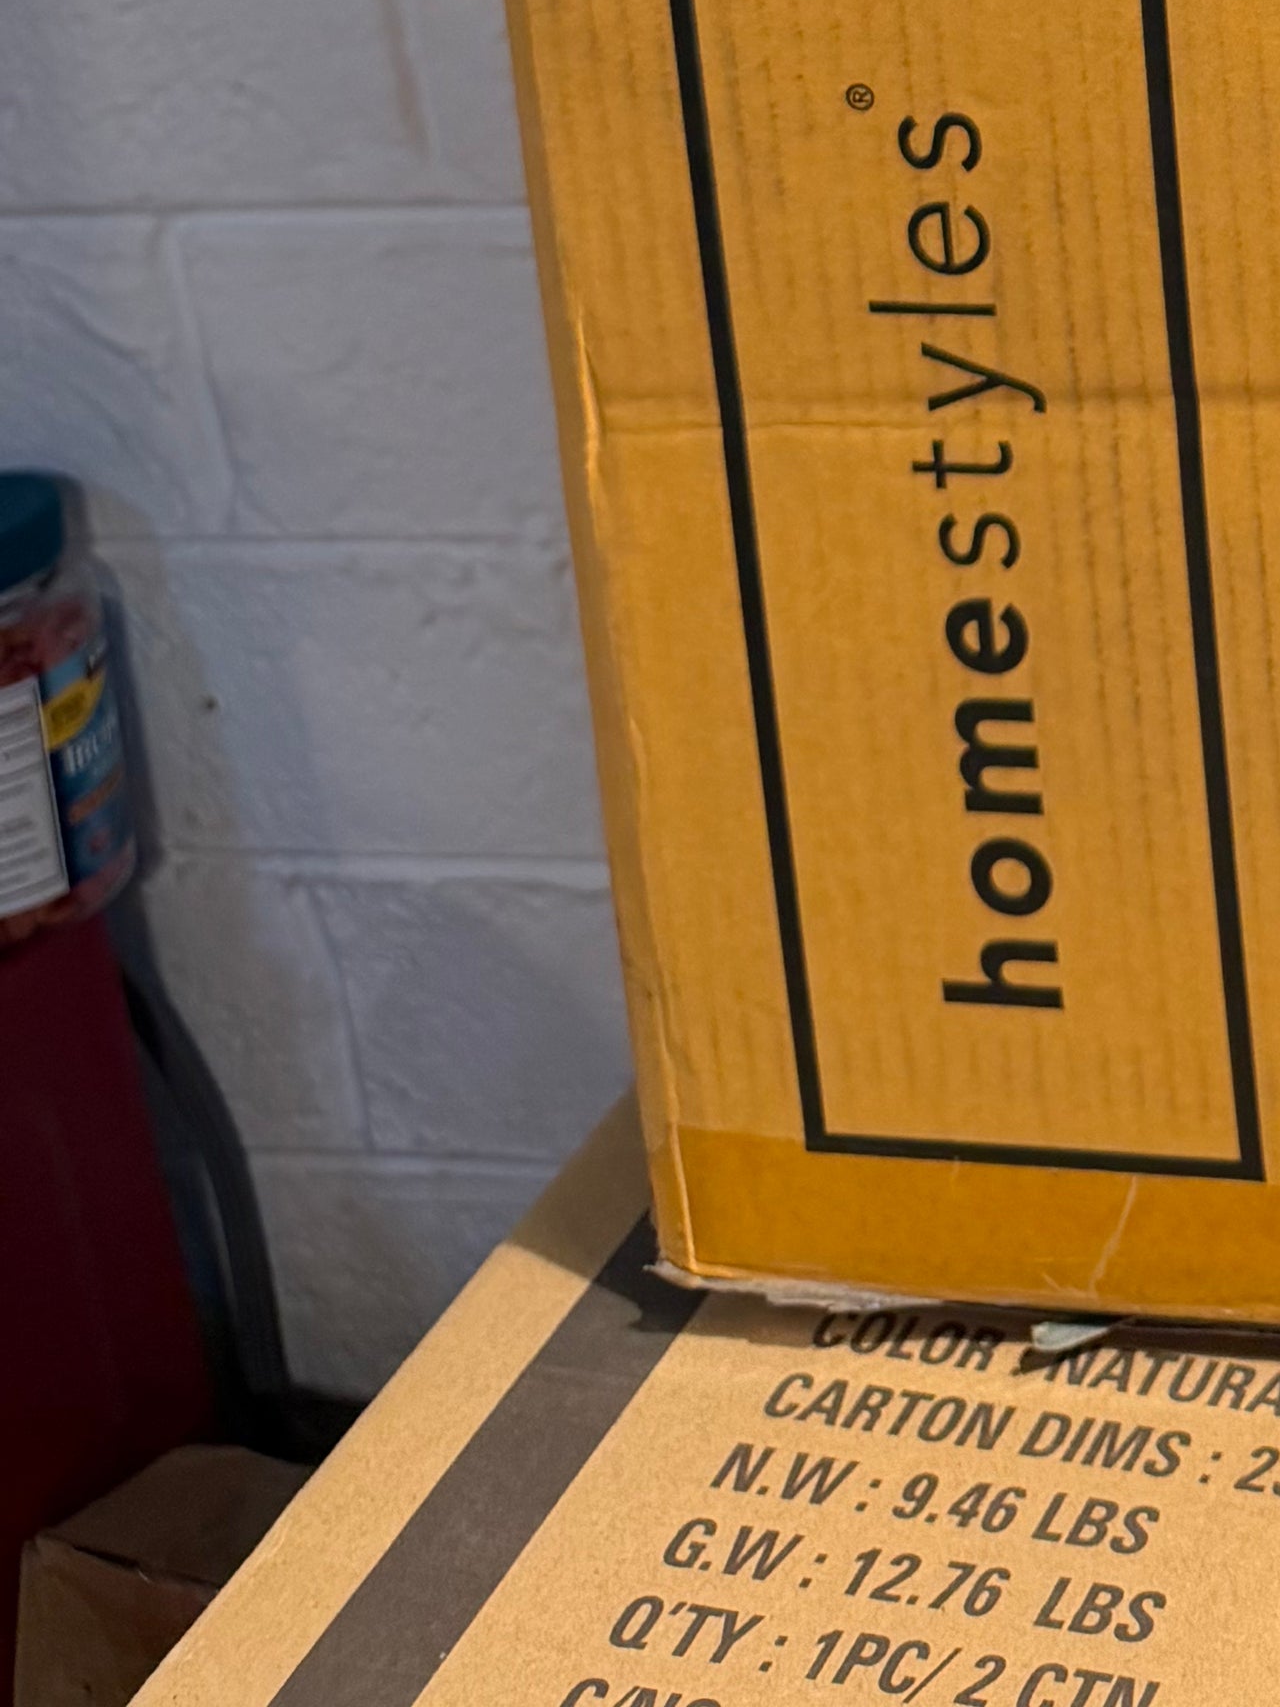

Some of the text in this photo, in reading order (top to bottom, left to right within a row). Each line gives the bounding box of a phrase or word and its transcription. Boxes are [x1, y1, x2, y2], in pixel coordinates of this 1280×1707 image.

[813, 1311, 1004, 1372] COLOR
[765, 1374, 1016, 1450] CARTON
[1019, 1412, 1191, 1477] DIMS
[711, 1444, 859, 1504] N.W
[893, 1474, 1026, 1532] 9.46
[1032, 1493, 1159, 1554] LBS
[664, 1519, 811, 1588] G.W
[845, 1549, 1010, 1616] 12.76
[1034, 1578, 1166, 1642] LBS
[954, 1656, 1006, 1707] 2
[1017, 1664, 1159, 1707] CTN
